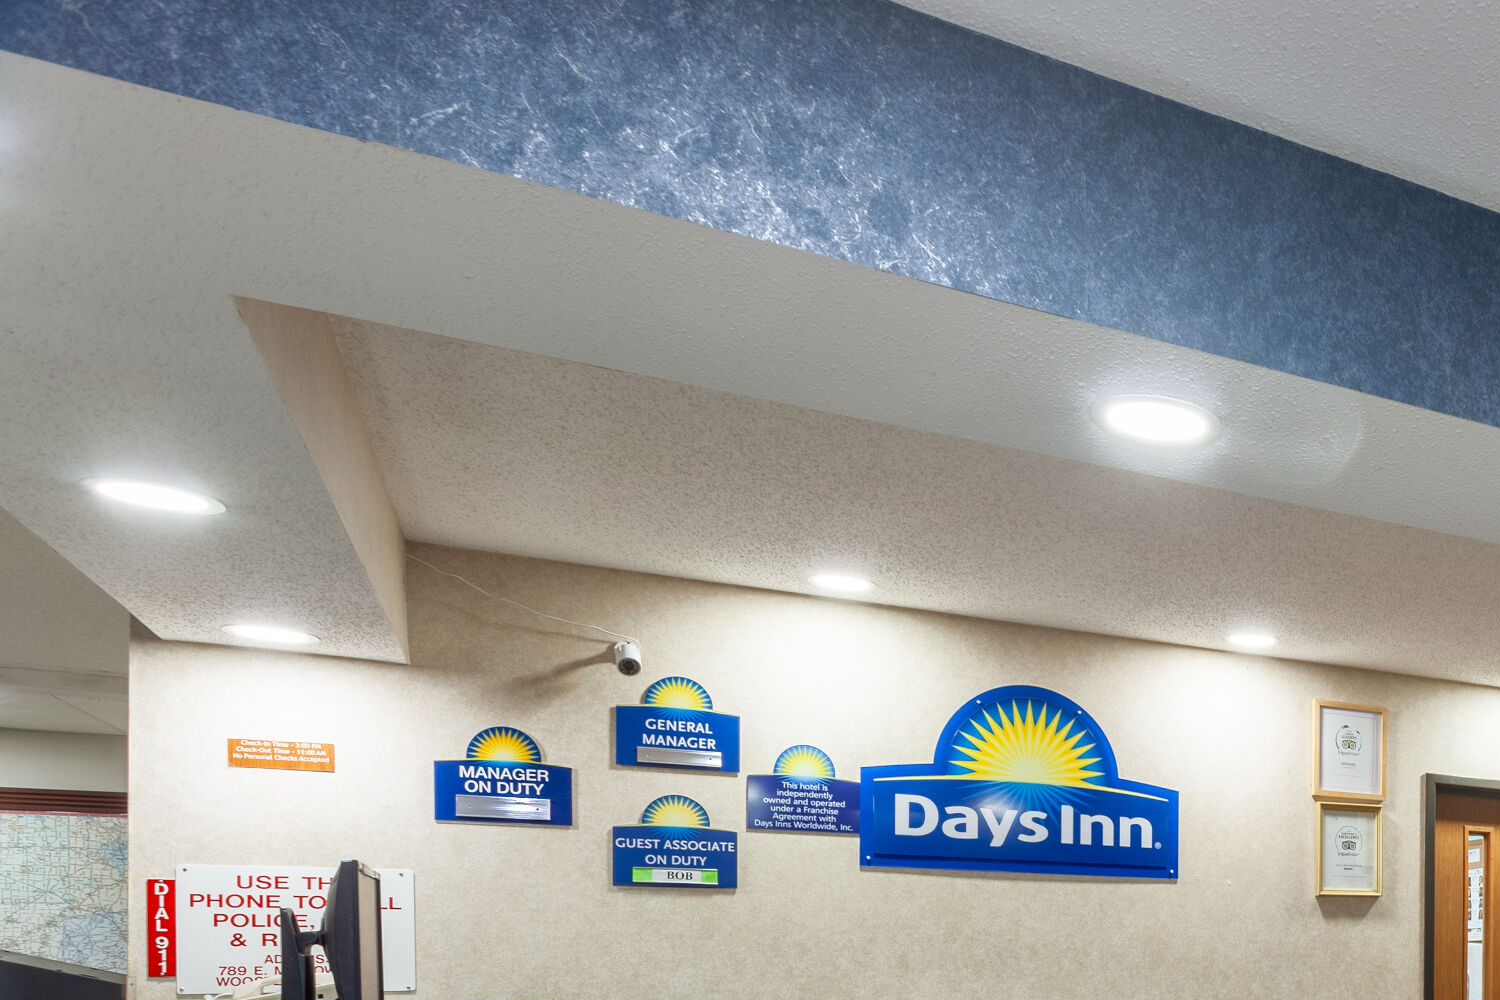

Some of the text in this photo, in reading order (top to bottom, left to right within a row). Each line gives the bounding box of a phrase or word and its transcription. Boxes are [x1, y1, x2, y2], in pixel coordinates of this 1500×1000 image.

[645, 718, 713, 734] GENERAL
[642, 733, 716, 749] MANAGER
[459, 765, 549, 782] MANAGER
[464, 780, 544, 795] ON DUTY
[782, 781, 798, 790] This
[776, 788, 833, 801] independently
[763, 796, 846, 808] owned and operated
[770, 805, 794, 813] under
[803, 806, 839, 815] Franchise
[754, 819, 773, 828] Days
[775, 820, 792, 828] Inns
[793, 821, 838, 831] Worldwide,
[772, 813, 837, 823] Agreement with
[894, 793, 1049, 847] Days
[615, 837, 735, 852] GUEST ASSOCIATE
[645, 854, 707, 866] ON DUTY
[667, 870, 693, 880] BOB
[236, 875, 335, 890] USE TH
[189, 893, 328, 910] PHONE TO
[153, 883, 169, 976] DIAL 911
[230, 933, 247, 947] &
[218, 966, 248, 976] 789
[253, 966, 268, 976] E.
